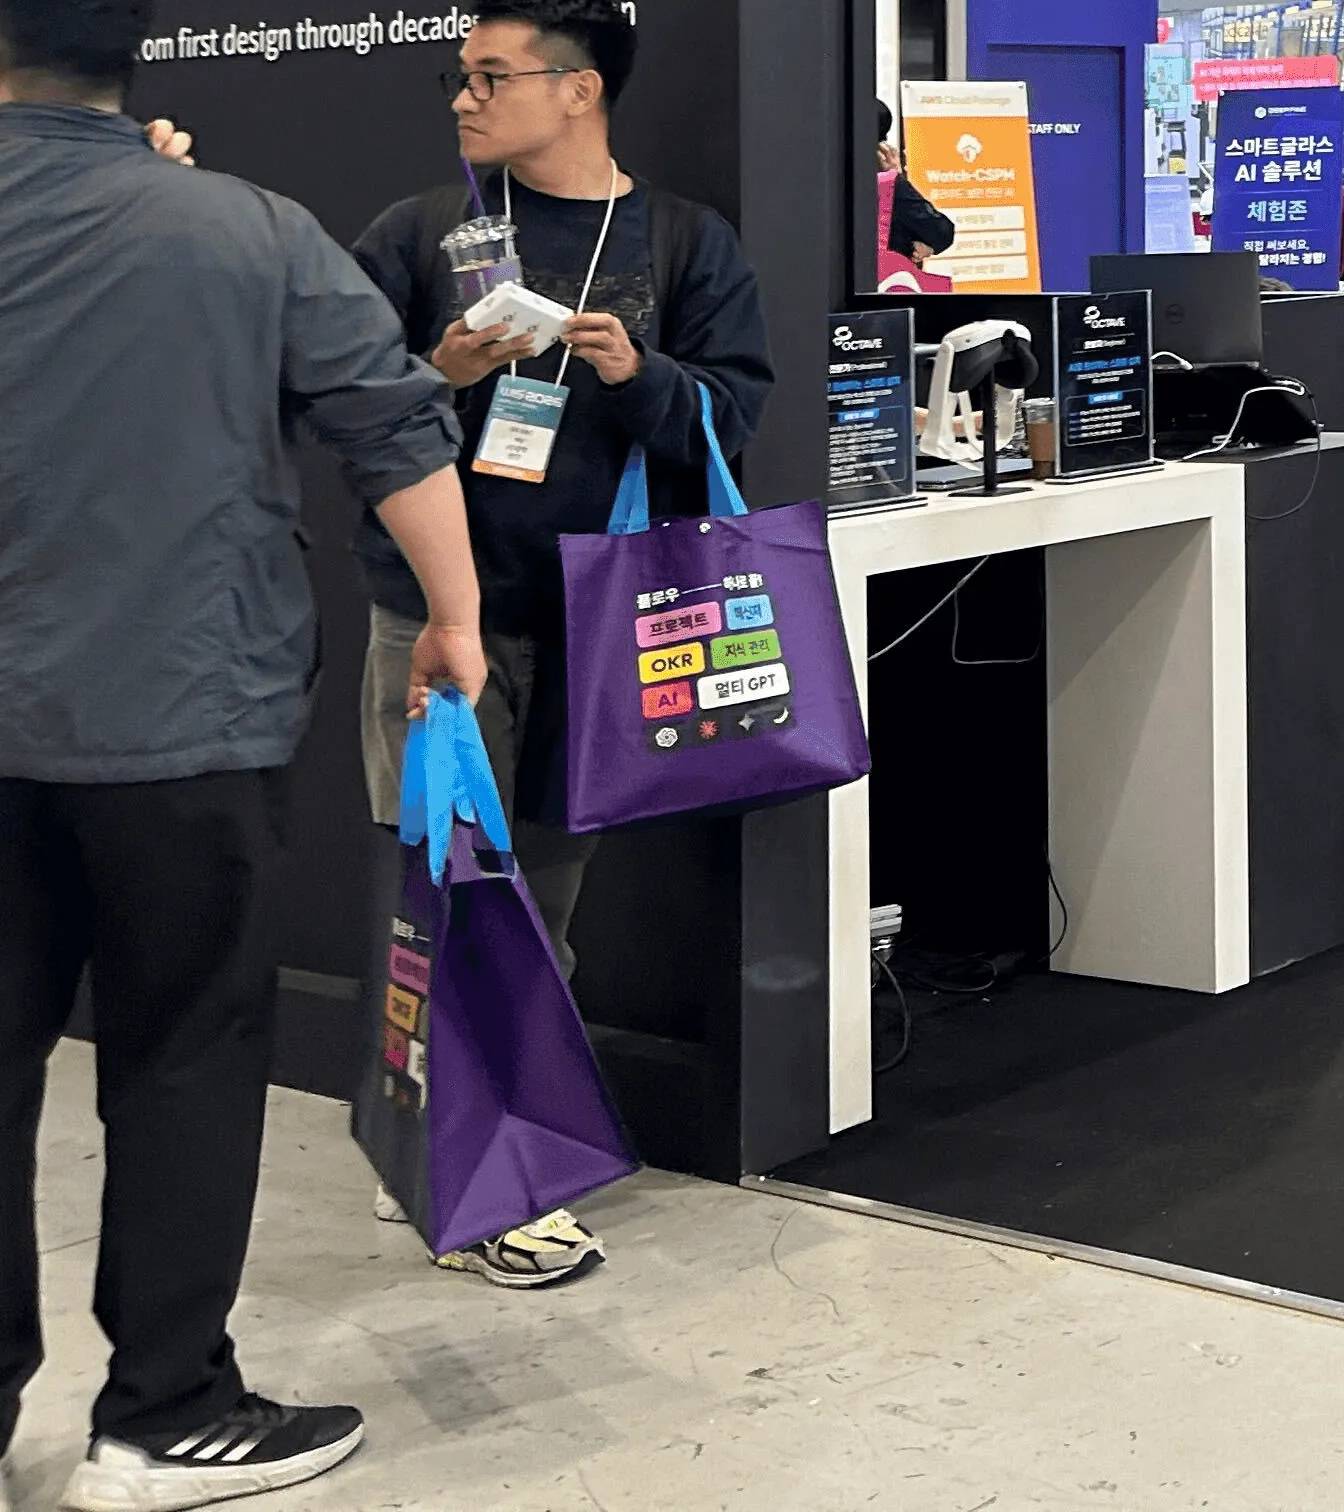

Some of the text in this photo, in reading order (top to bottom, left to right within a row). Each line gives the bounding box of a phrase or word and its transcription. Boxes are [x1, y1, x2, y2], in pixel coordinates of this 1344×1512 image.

[178, 27, 218, 59] first
[222, 22, 291, 61] design
[296, 13, 384, 55] through
[1054, 123, 1081, 134] ONLY
[1224, 136, 1334, 158] 스마트글라스
[1235, 159, 1322, 183] AI 솔루션
[1247, 200, 1307, 222] 체험존
[1091, 317, 1126, 329] OCTAVE
[841, 338, 883, 351] OCTAVE
[636, 587, 680, 610] 플로우
[648, 612, 709, 637] 프로젝트
[725, 640, 769, 659] 지식 관리
[651, 653, 693, 673] OKR
[715, 673, 776, 699] 멀티 GPT
[657, 691, 678, 709] AI
